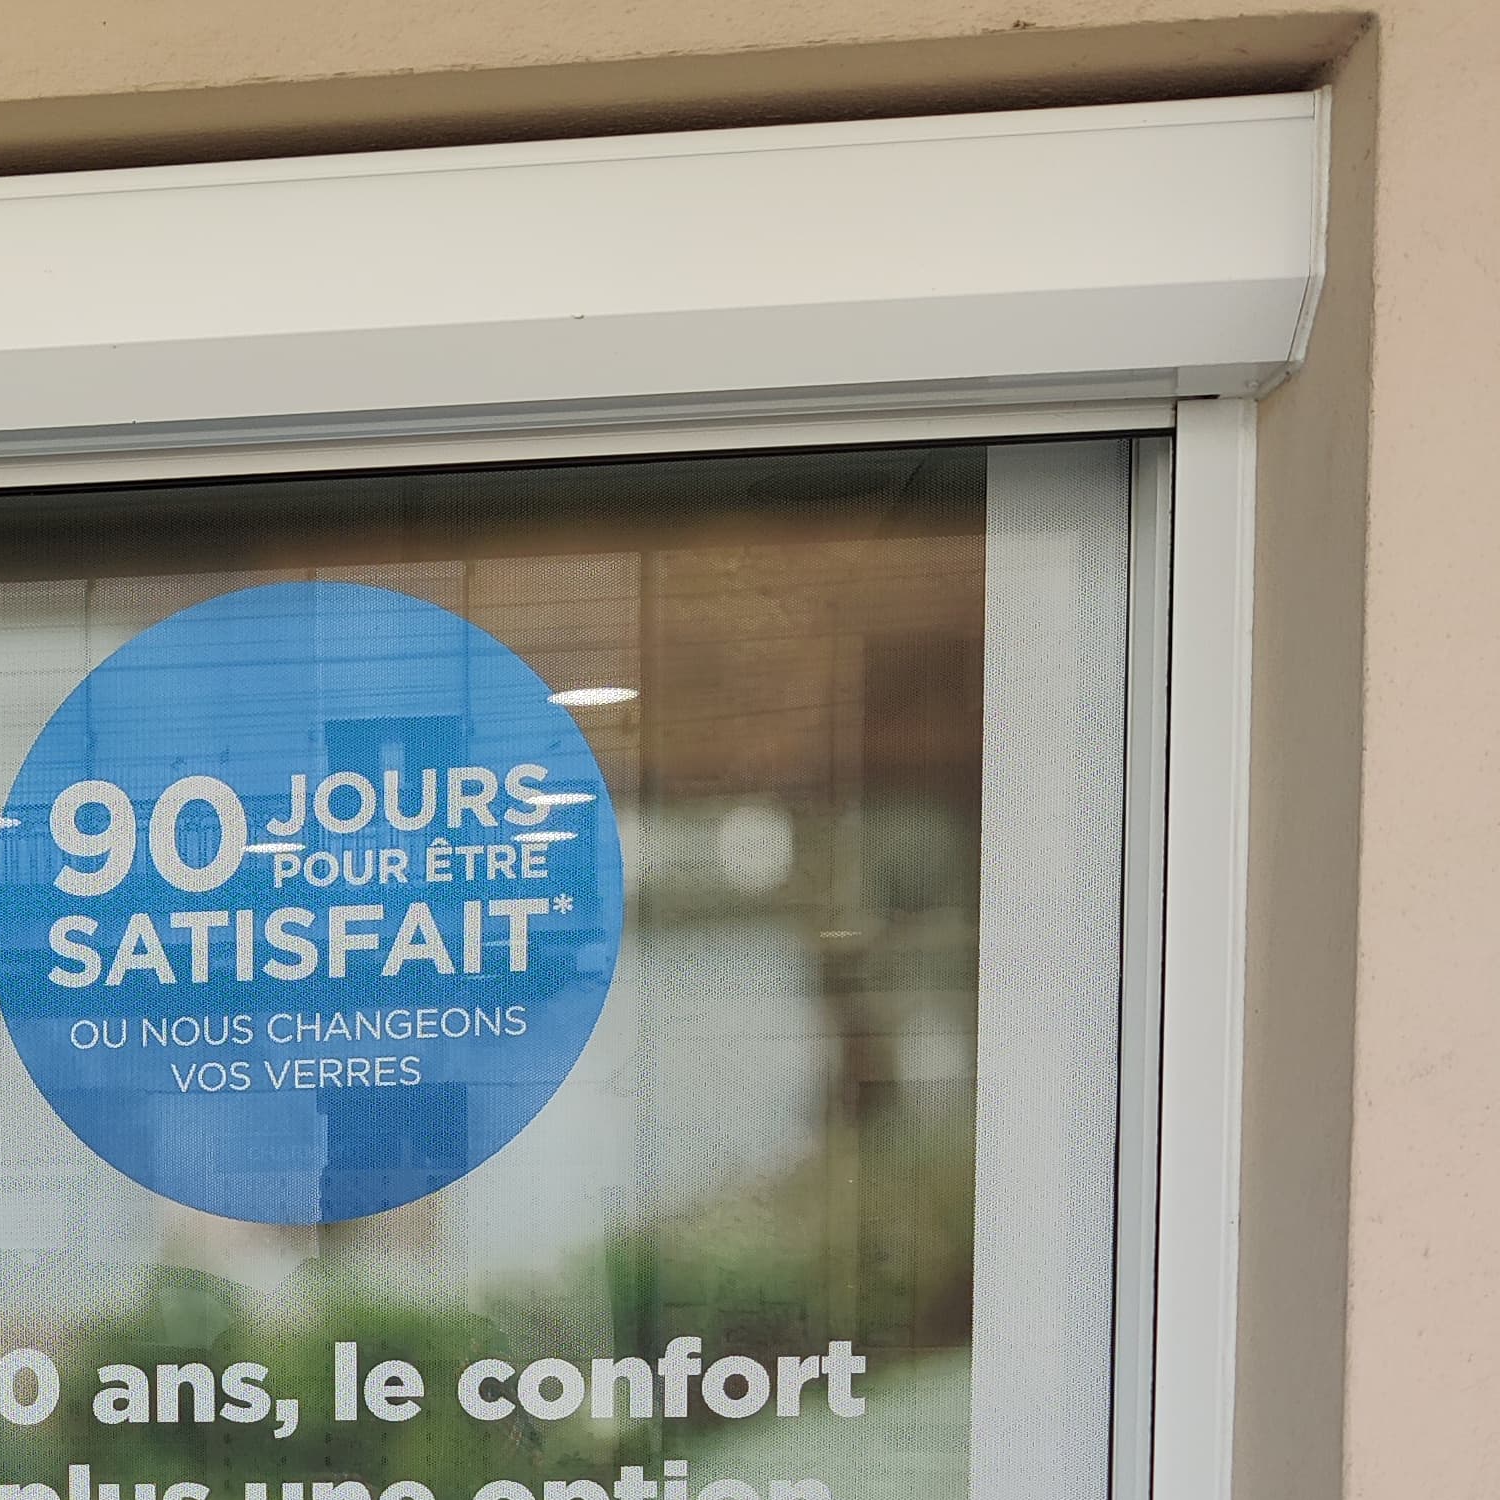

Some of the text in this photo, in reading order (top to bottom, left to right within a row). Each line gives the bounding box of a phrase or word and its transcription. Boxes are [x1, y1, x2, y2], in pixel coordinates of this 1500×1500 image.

[48, 764, 551, 897] 90 JOURS
[273, 838, 549, 889] POUR ÊTRE
[69, 1005, 528, 1051] OU NOUS CHANGEONS
[171, 1056, 422, 1093] VOS VERRES
[95, 1358, 299, 1438] ans,
[333, 1341, 426, 1423] le
[458, 1336, 867, 1421] confort
